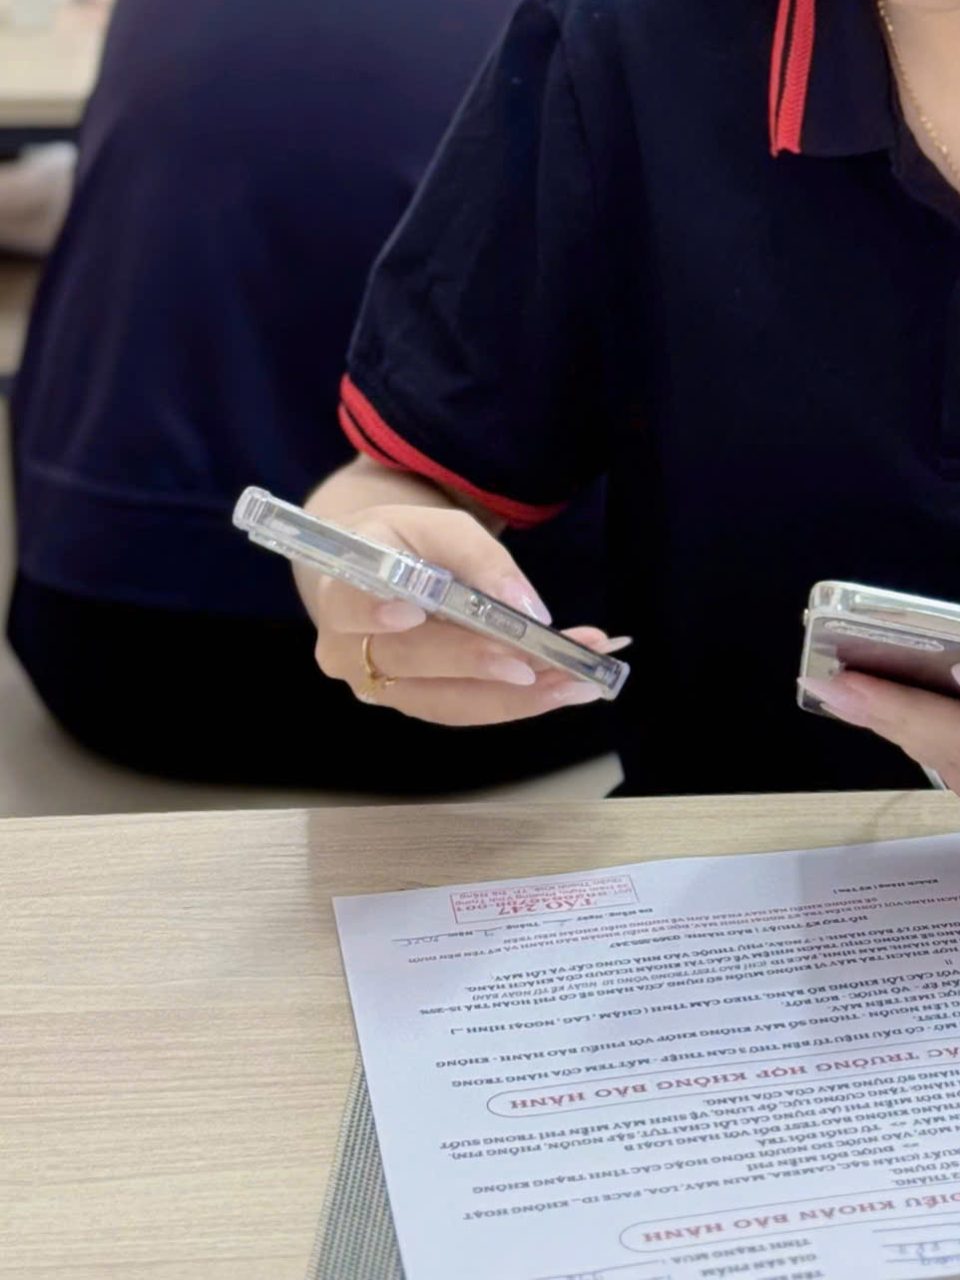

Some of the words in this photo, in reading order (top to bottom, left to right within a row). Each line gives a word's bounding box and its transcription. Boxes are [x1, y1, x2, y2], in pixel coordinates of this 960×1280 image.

[497, 902, 535, 915] 247
[544, 898, 591, 909] TÁO
[755, 1065, 807, 1078] HỢP
[655, 1071, 747, 1090] KHÔNG
[594, 1083, 647, 1097] BẢO
[510, 1091, 585, 1108] HÀNH
[798, 1199, 895, 1220] KHOẢN
[732, 1213, 789, 1228] BẢO
[642, 1222, 723, 1242] HÀNH
